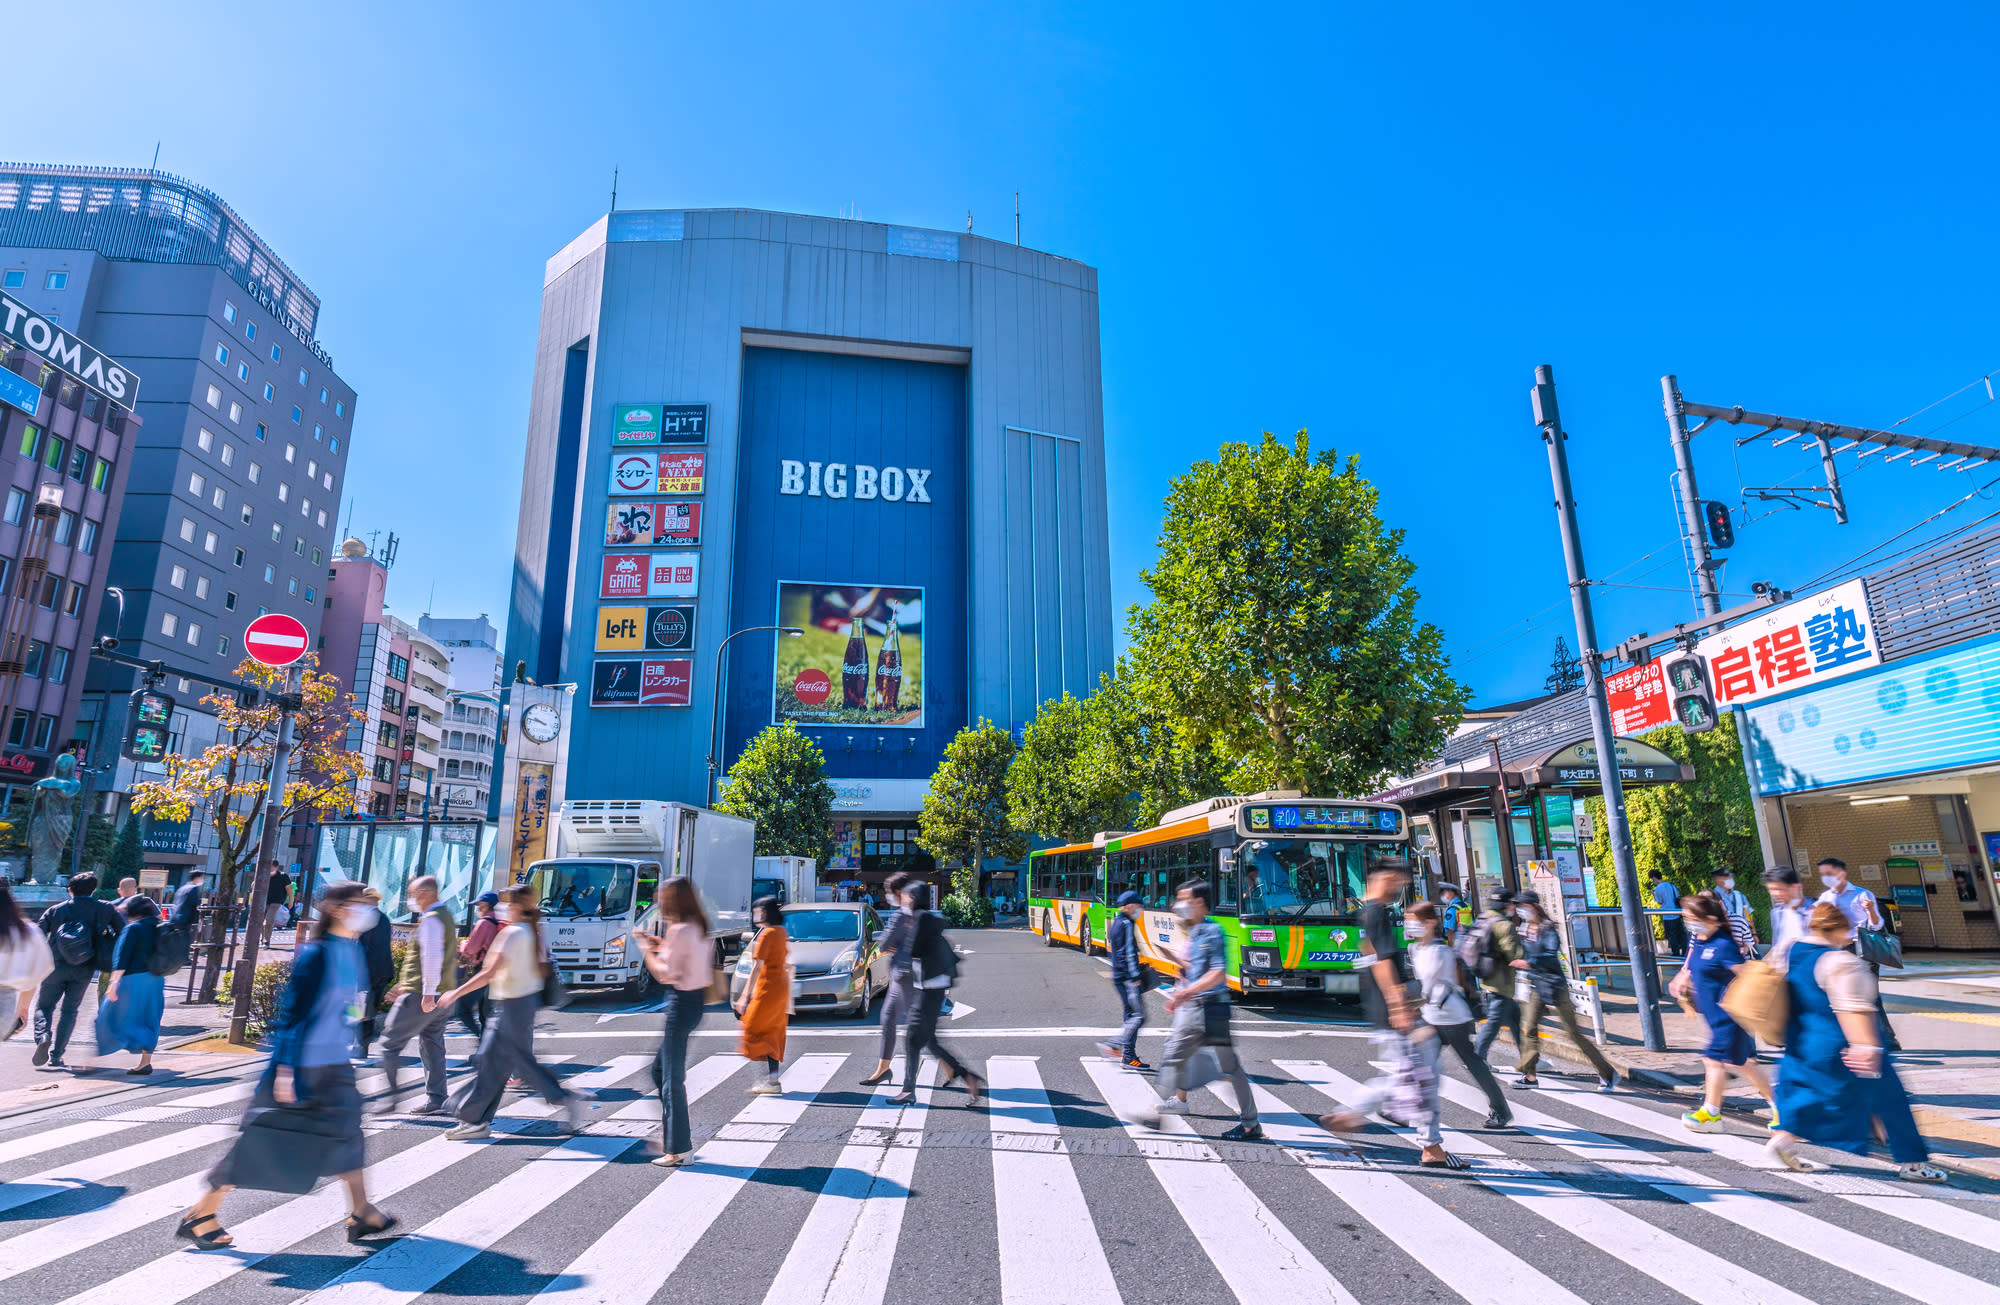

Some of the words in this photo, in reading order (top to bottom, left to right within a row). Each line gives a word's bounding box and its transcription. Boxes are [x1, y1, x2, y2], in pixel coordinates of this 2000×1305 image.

[2, 297, 127, 398] TOMAS
[618, 431, 656, 440] サイゼリヤ
[616, 469, 653, 478] スシロー
[666, 468, 696, 477] NEXT
[780, 459, 847, 498] BIG
[854, 464, 931, 503] BOX
[659, 483, 700, 491] 食べ放題
[609, 574, 641, 588] GAME
[645, 665, 665, 675] 日産
[645, 676, 688, 686] レンタカー
[1607, 664, 1660, 695] 留学生向けの
[795, 681, 829, 692] Coca-Cola
[1634, 678, 1664, 701] 進学塾
[1644, 768, 1654, 778] 行
[1275, 808, 1296, 826] 学02
[1304, 809, 1365, 824] 早大正門
[1579, 818, 1586, 827] 2
